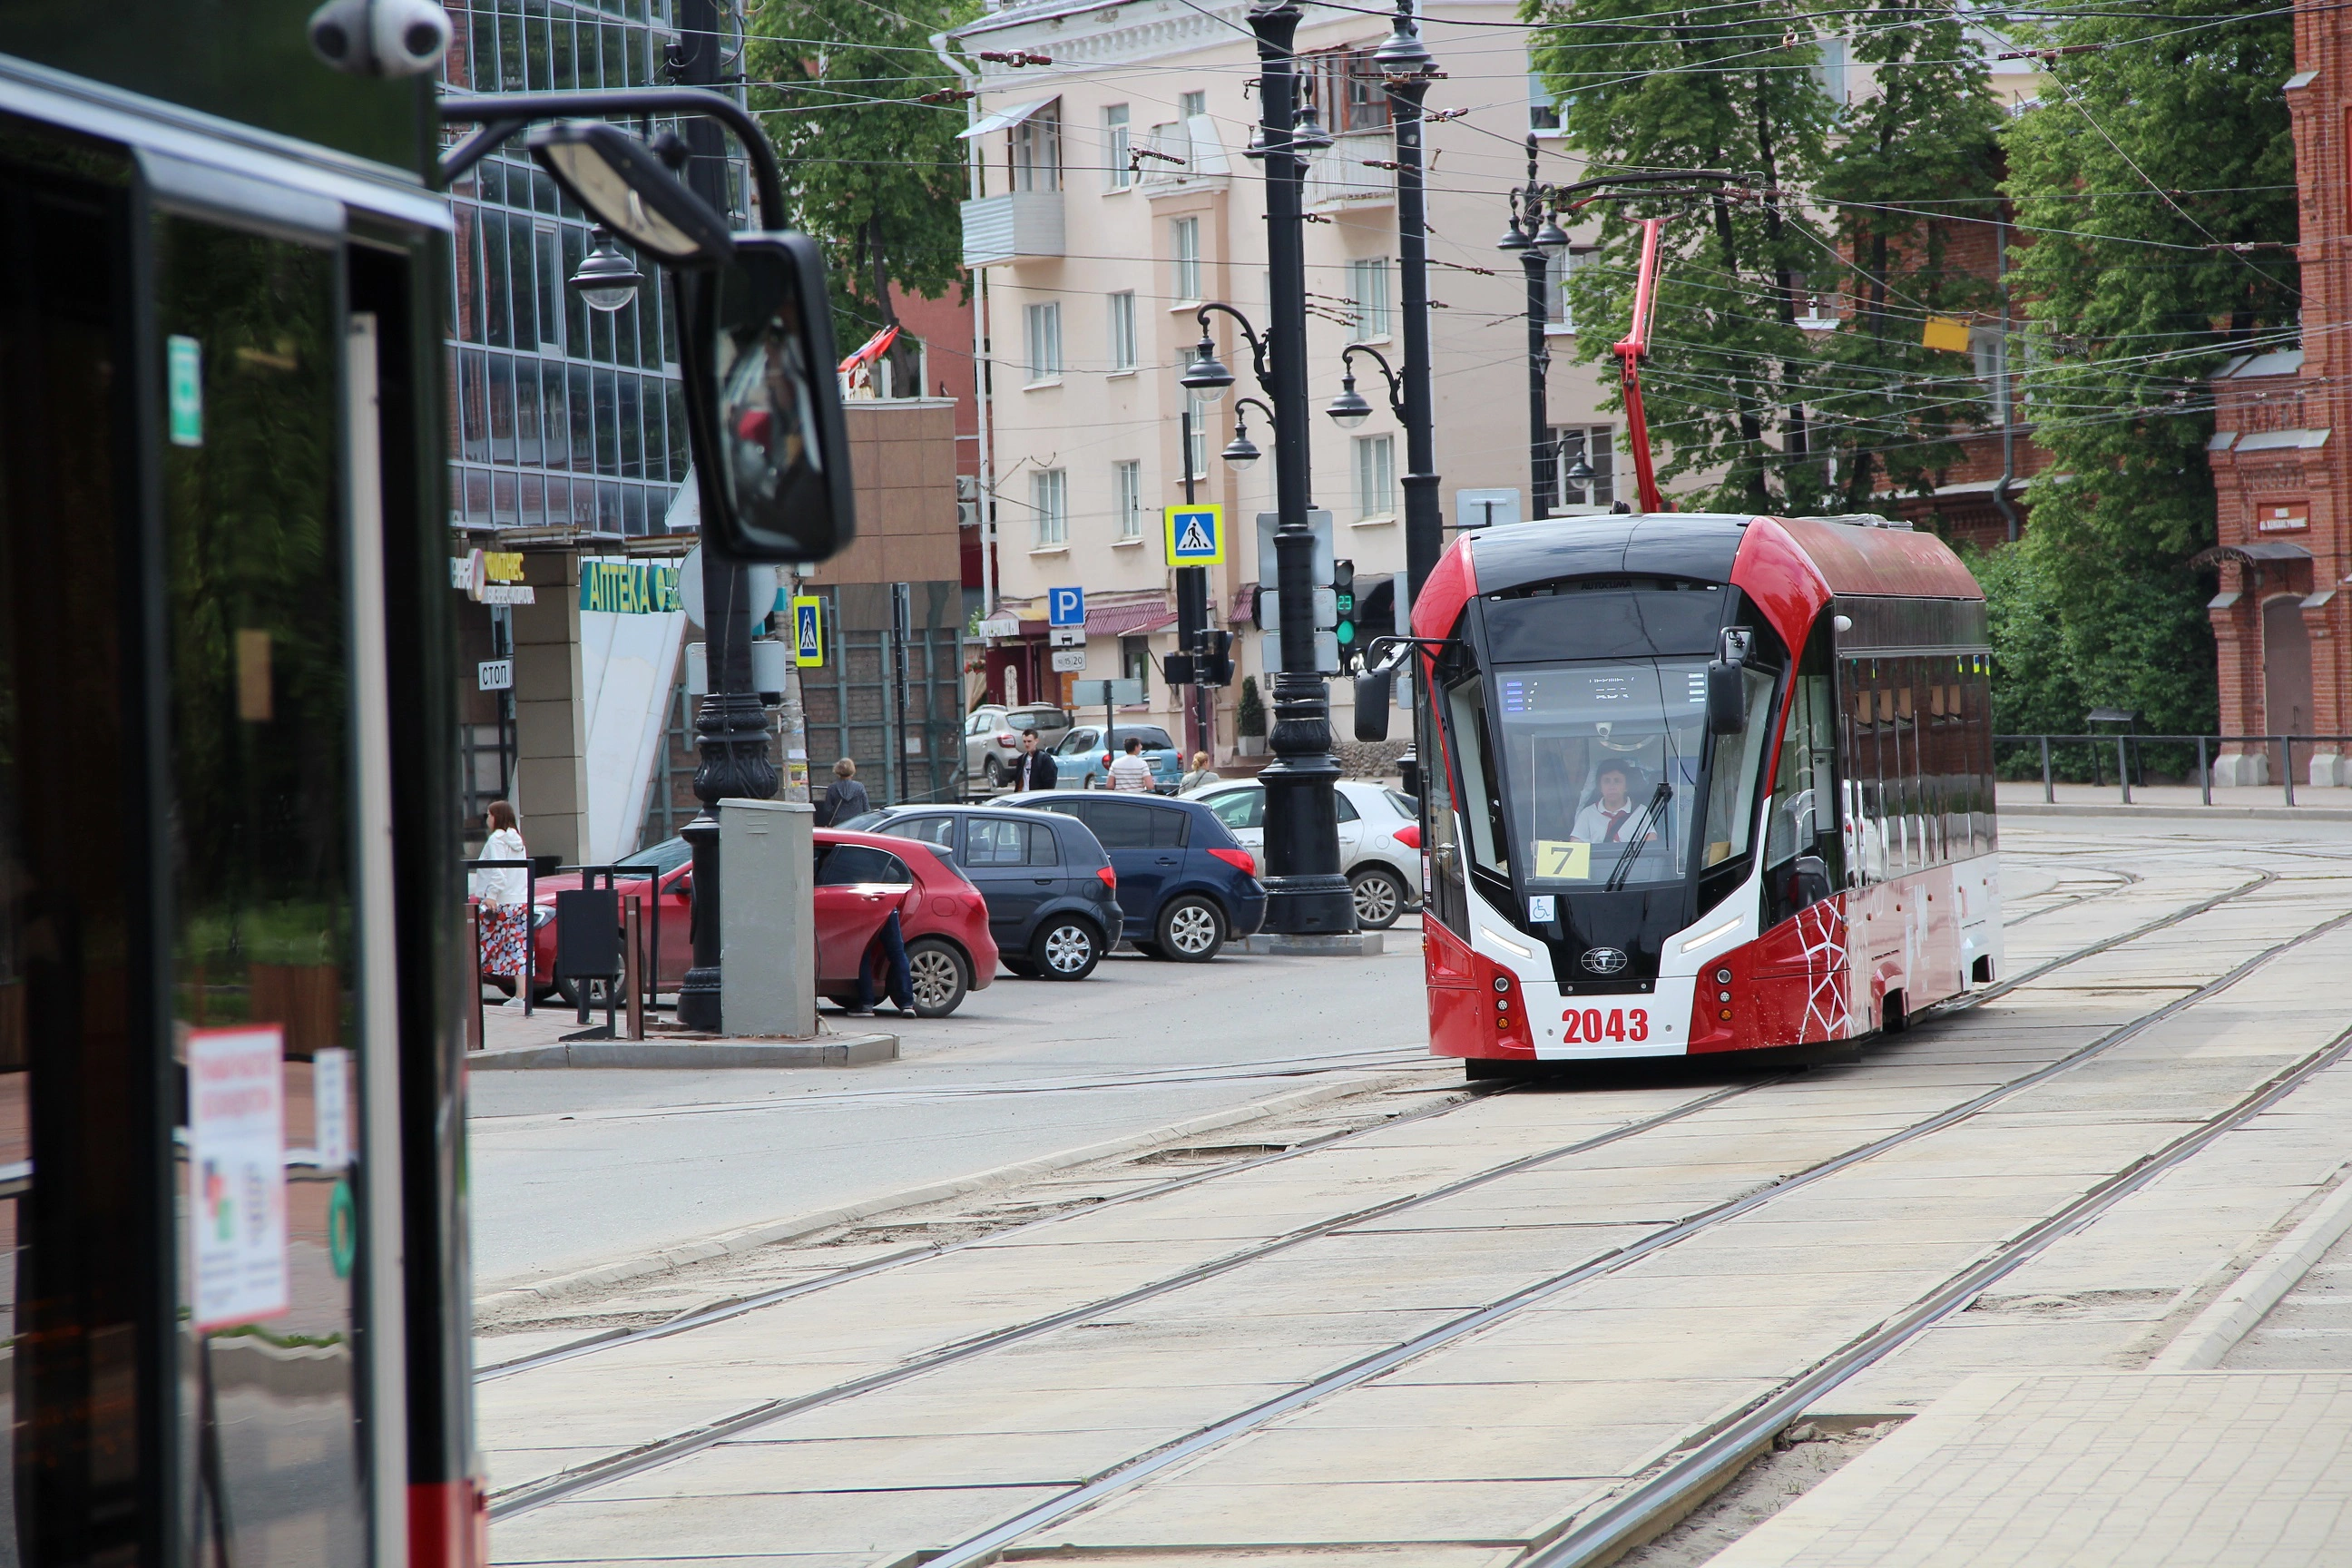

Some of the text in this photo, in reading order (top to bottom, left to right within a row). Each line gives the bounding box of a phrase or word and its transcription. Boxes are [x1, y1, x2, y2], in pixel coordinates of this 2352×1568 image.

[588, 562, 652, 614] АПТЕКА
[1058, 591, 1078, 622] P
[1338, 595, 1352, 610] 23
[1064, 657, 1071, 665] 15
[1073, 656, 1083, 665] 20
[482, 665, 507, 685] СТОП
[1550, 847, 1574, 875] 7
[1562, 1008, 1649, 1044] 2043
